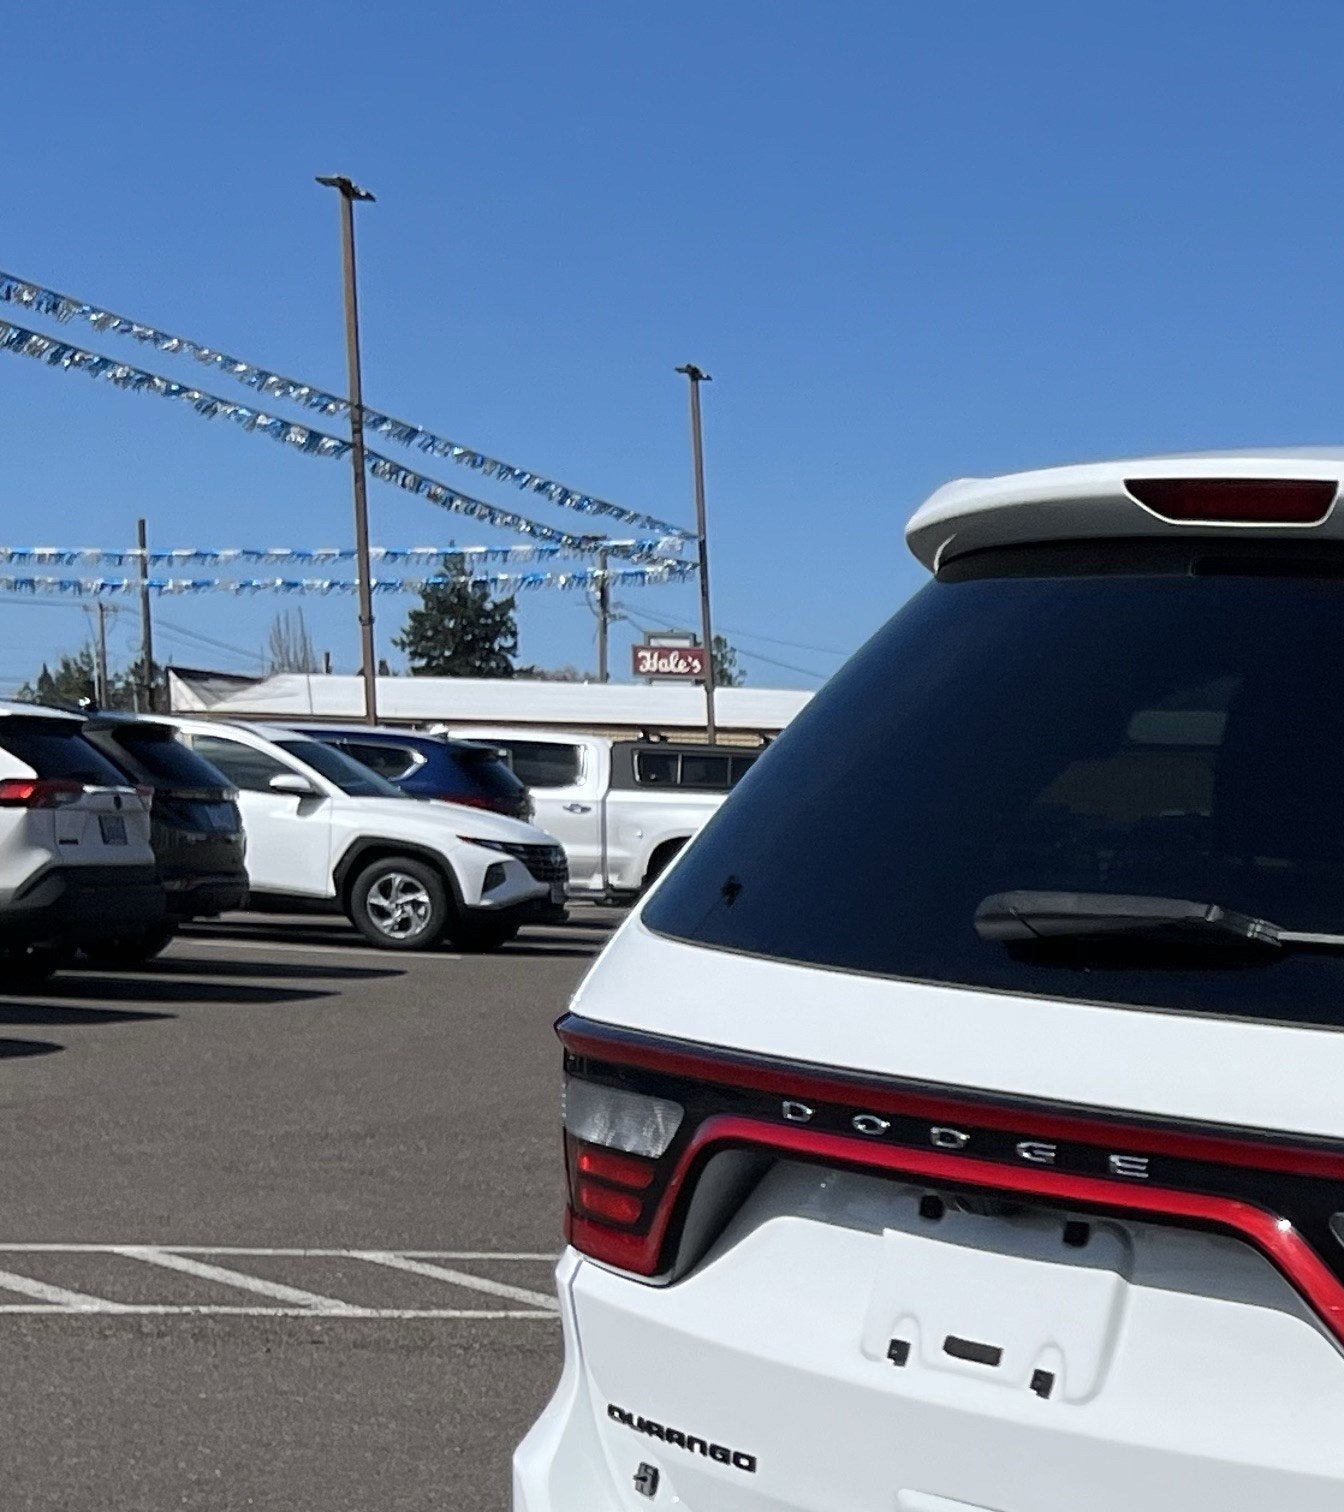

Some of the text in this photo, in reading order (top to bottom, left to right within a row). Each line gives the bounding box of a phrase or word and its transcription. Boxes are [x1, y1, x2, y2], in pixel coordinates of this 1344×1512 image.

[637, 649, 702, 674] Hale's
[782, 1100, 1149, 1179] DODGE
[607, 1403, 757, 1473] DURANGO
